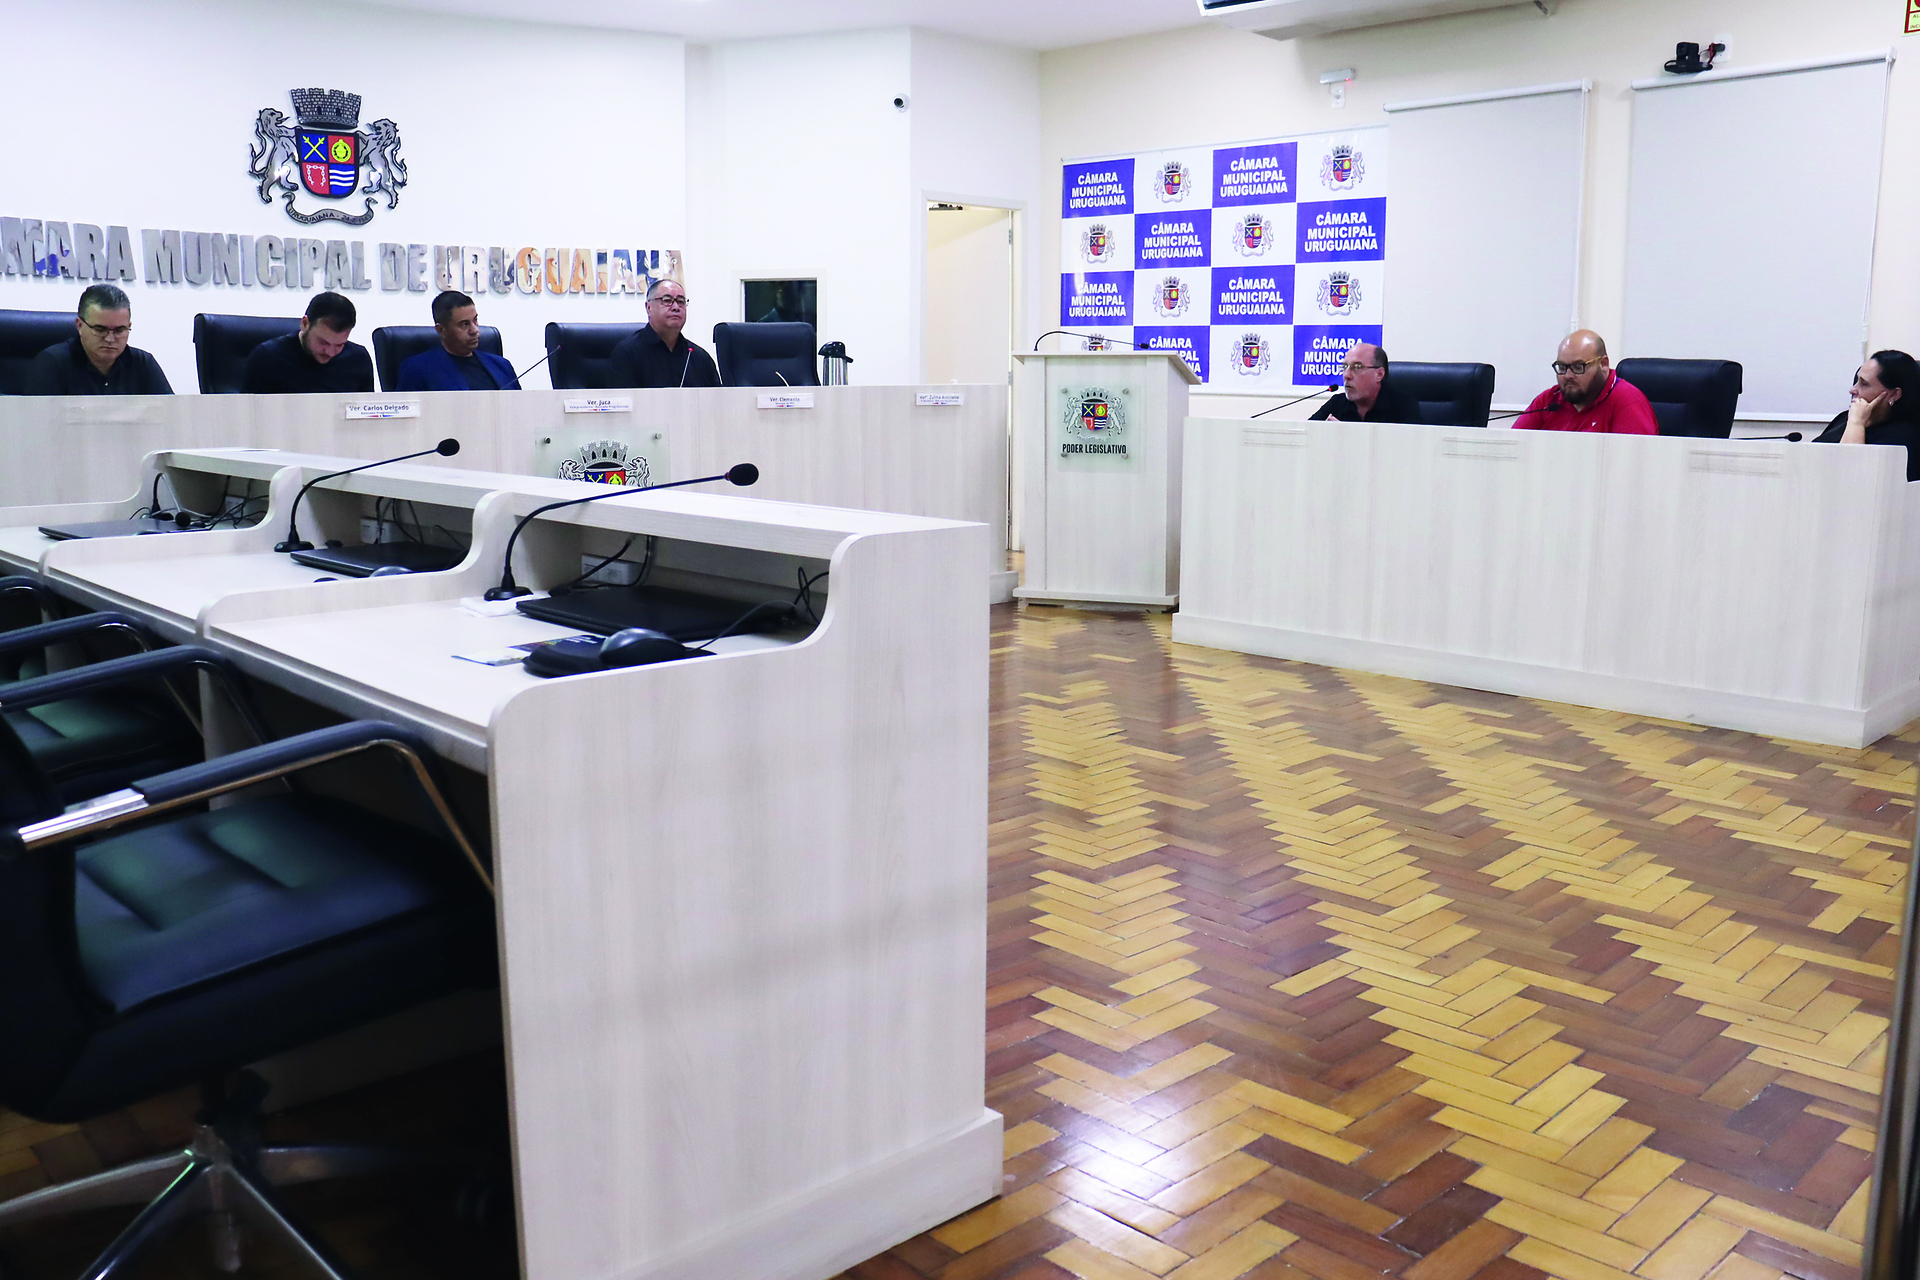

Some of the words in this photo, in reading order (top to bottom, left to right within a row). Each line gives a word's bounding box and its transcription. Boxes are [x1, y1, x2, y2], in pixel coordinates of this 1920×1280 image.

[1230, 157, 1278, 172] CÂMARA
[1077, 172, 1118, 185] CÂMARA
[1222, 170, 1286, 185] MUNICIPAL
[1071, 184, 1124, 197] MUNICIPAL
[1220, 182, 1288, 197] URUGUAIANA
[1069, 195, 1126, 209] URUGUAIANA
[289, 208, 335, 222] URUGUAIANA
[1316, 211, 1367, 226] CÂMARA
[1150, 222, 1194, 235] CÂMARA
[1307, 226, 1375, 240] MUNICIPAL
[1144, 235, 1201, 248] MUNICIPAL
[1304, 239, 1378, 252] URUGUAIANA
[0, 216, 137, 281] MARA
[141, 229, 373, 291] MUNICIPAL
[379, 243, 428, 292] DE
[433, 246, 686, 295] URUGUAIANA
[1141, 247, 1203, 259] URUGUAIANA
[1077, 282, 1118, 294] CÂMARA
[1228, 277, 1276, 290] CÂMARA
[1071, 295, 1124, 306] MUNICIPAL
[1221, 291, 1283, 304] MUNICIPAL
[1069, 306, 1126, 318] URUGUAIANA
[1218, 303, 1285, 316] URUGUAIANA
[1149, 335, 1192, 349] CÂMARA
[1304, 351, 1347, 363] MUNIC
[1301, 364, 1344, 375] URUGU
[384, 404, 409, 413] Delgado
[1062, 443, 1084, 453] PODER
[1085, 444, 1127, 454] LEGISLATIVO
